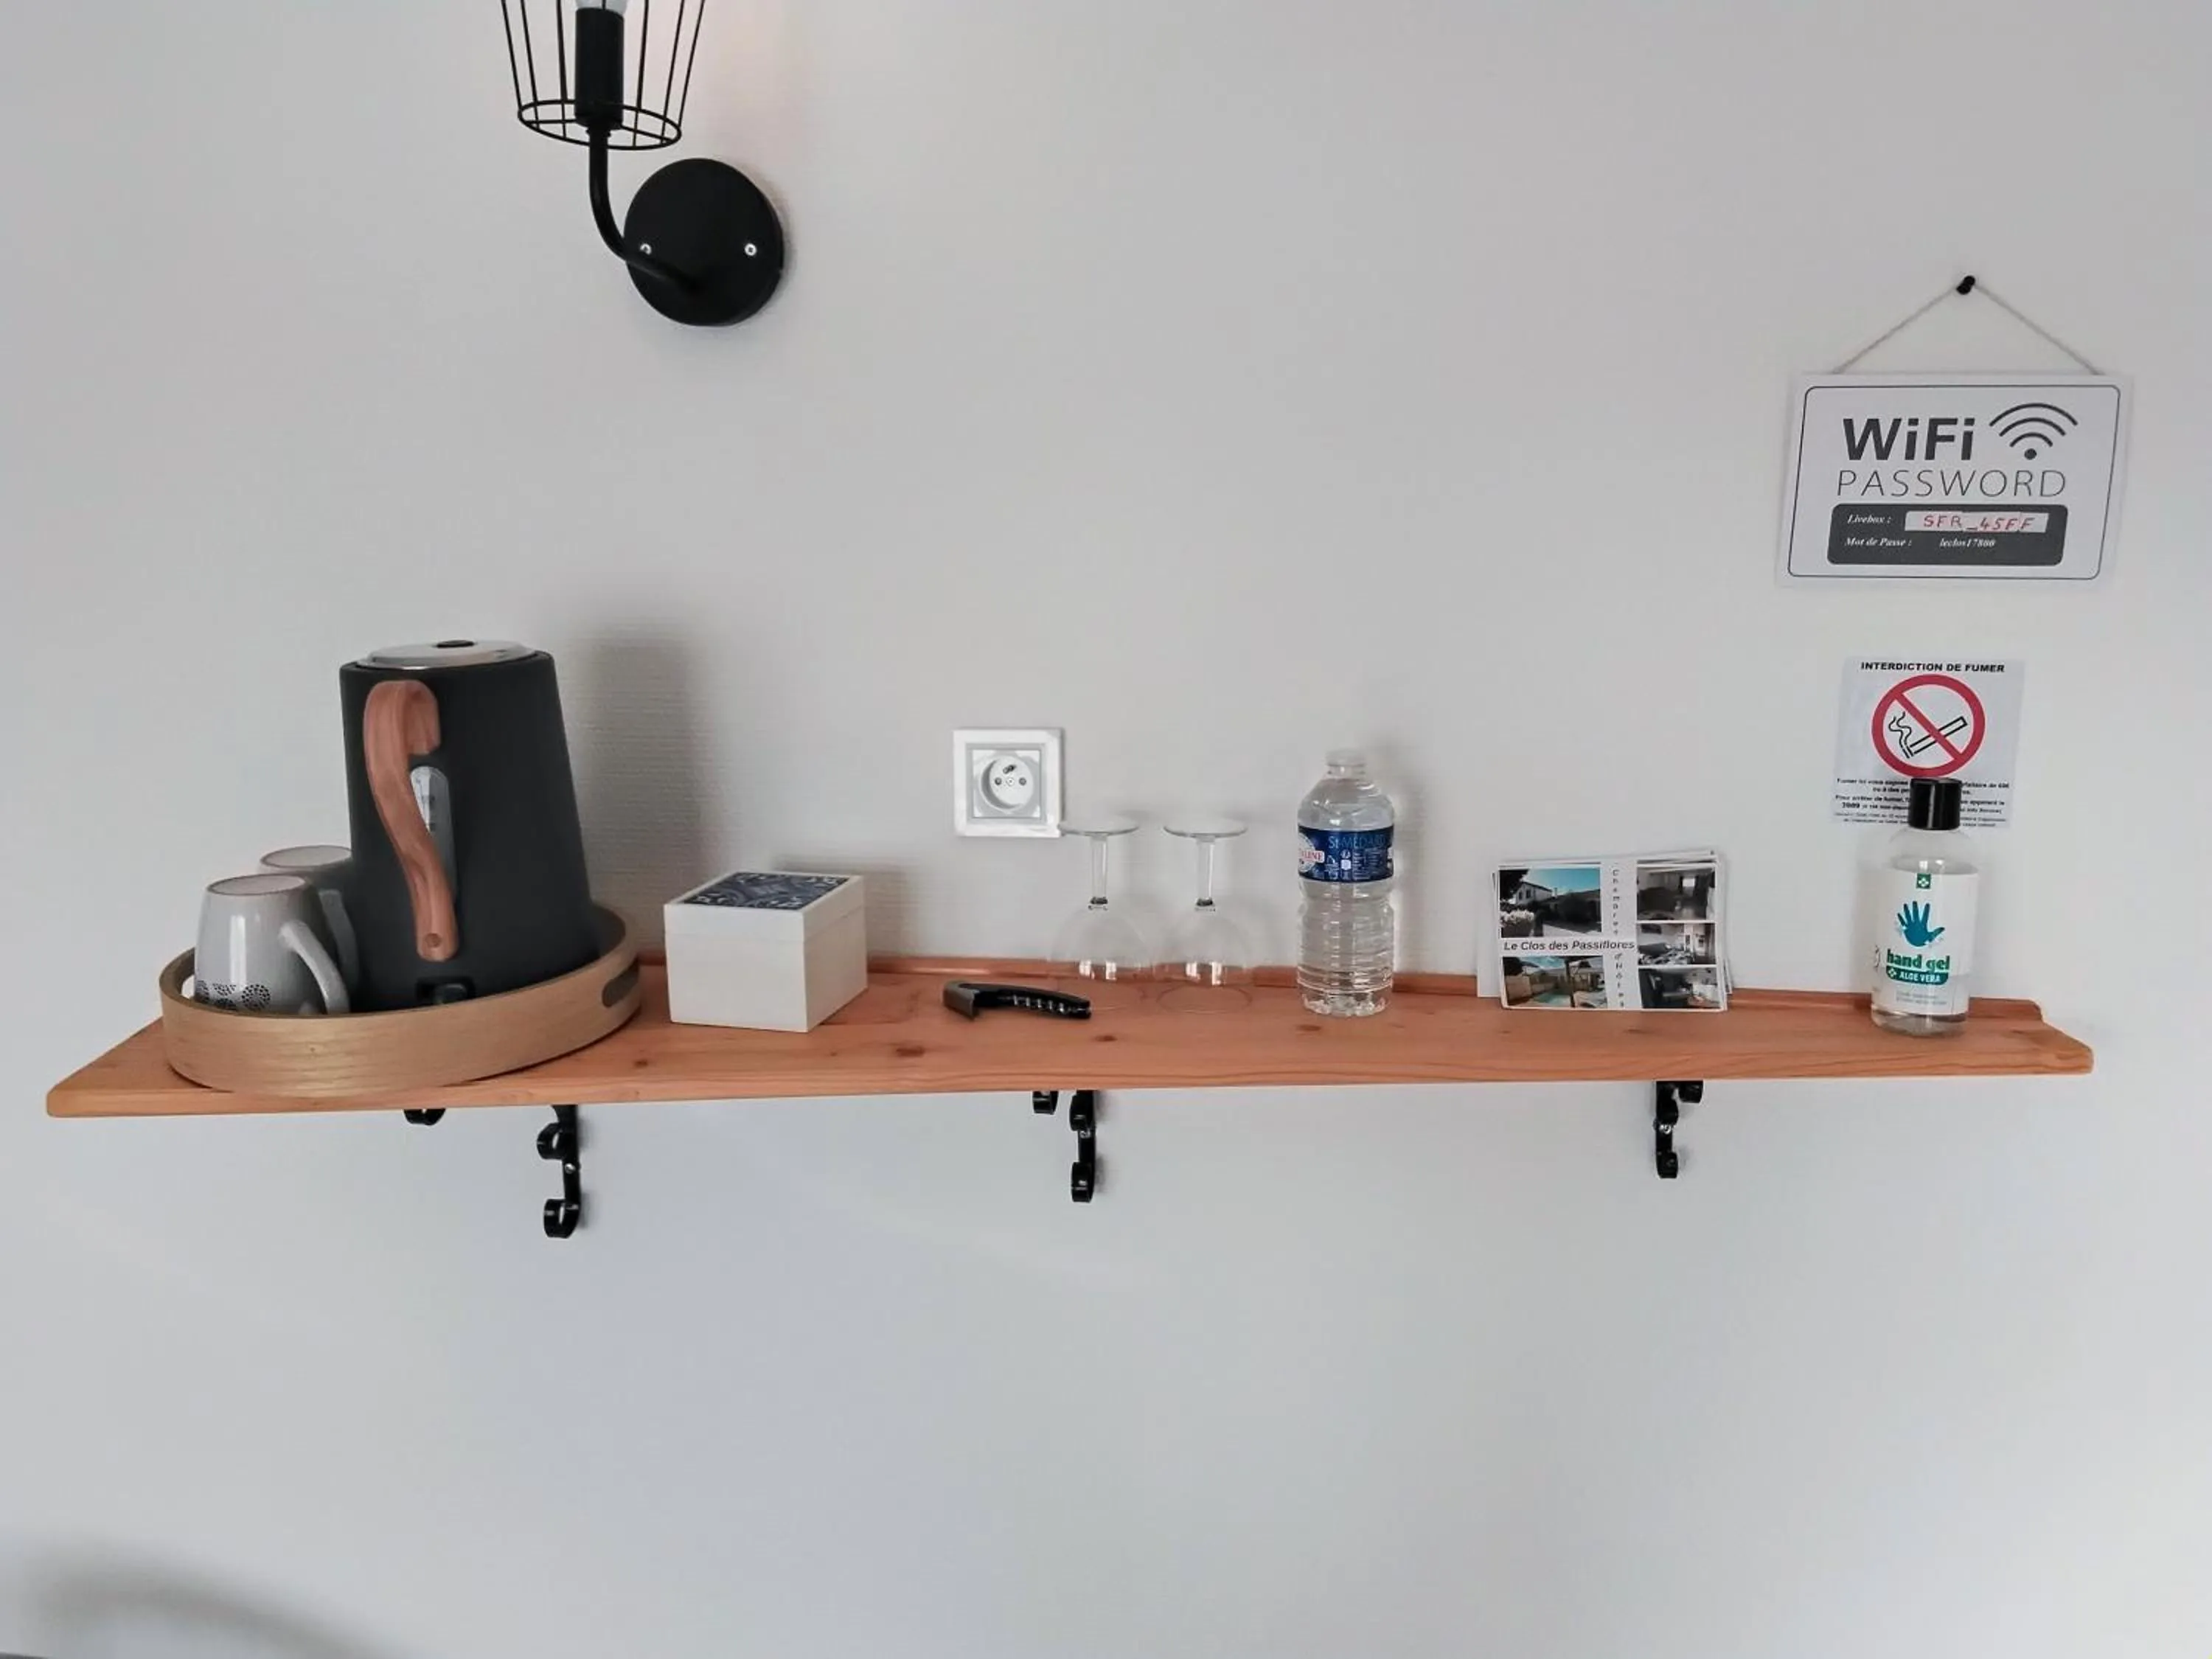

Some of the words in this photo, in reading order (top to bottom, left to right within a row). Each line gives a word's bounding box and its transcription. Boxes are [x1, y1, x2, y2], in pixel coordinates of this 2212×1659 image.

[1843, 417, 1975, 461] WiFi
[1837, 469, 2067, 498] PASSWORD
[1845, 538, 1865, 546] Mot
[1865, 537, 1879, 546] de
[1879, 538, 1906, 547] Passe
[1860, 662, 1943, 672] INTERDICTION
[1946, 663, 1962, 672] DE
[1965, 664, 2006, 673] FUMER
[1503, 941, 1518, 950] Le
[1520, 940, 1545, 950] Clos
[1549, 940, 1568, 950] des
[1571, 939, 1635, 950] Passiflores
[1887, 948, 1922, 968] hand
[1926, 955, 1950, 973] gel
[1899, 971, 1919, 981] ALOE
[1919, 973, 1941, 983] VERA
